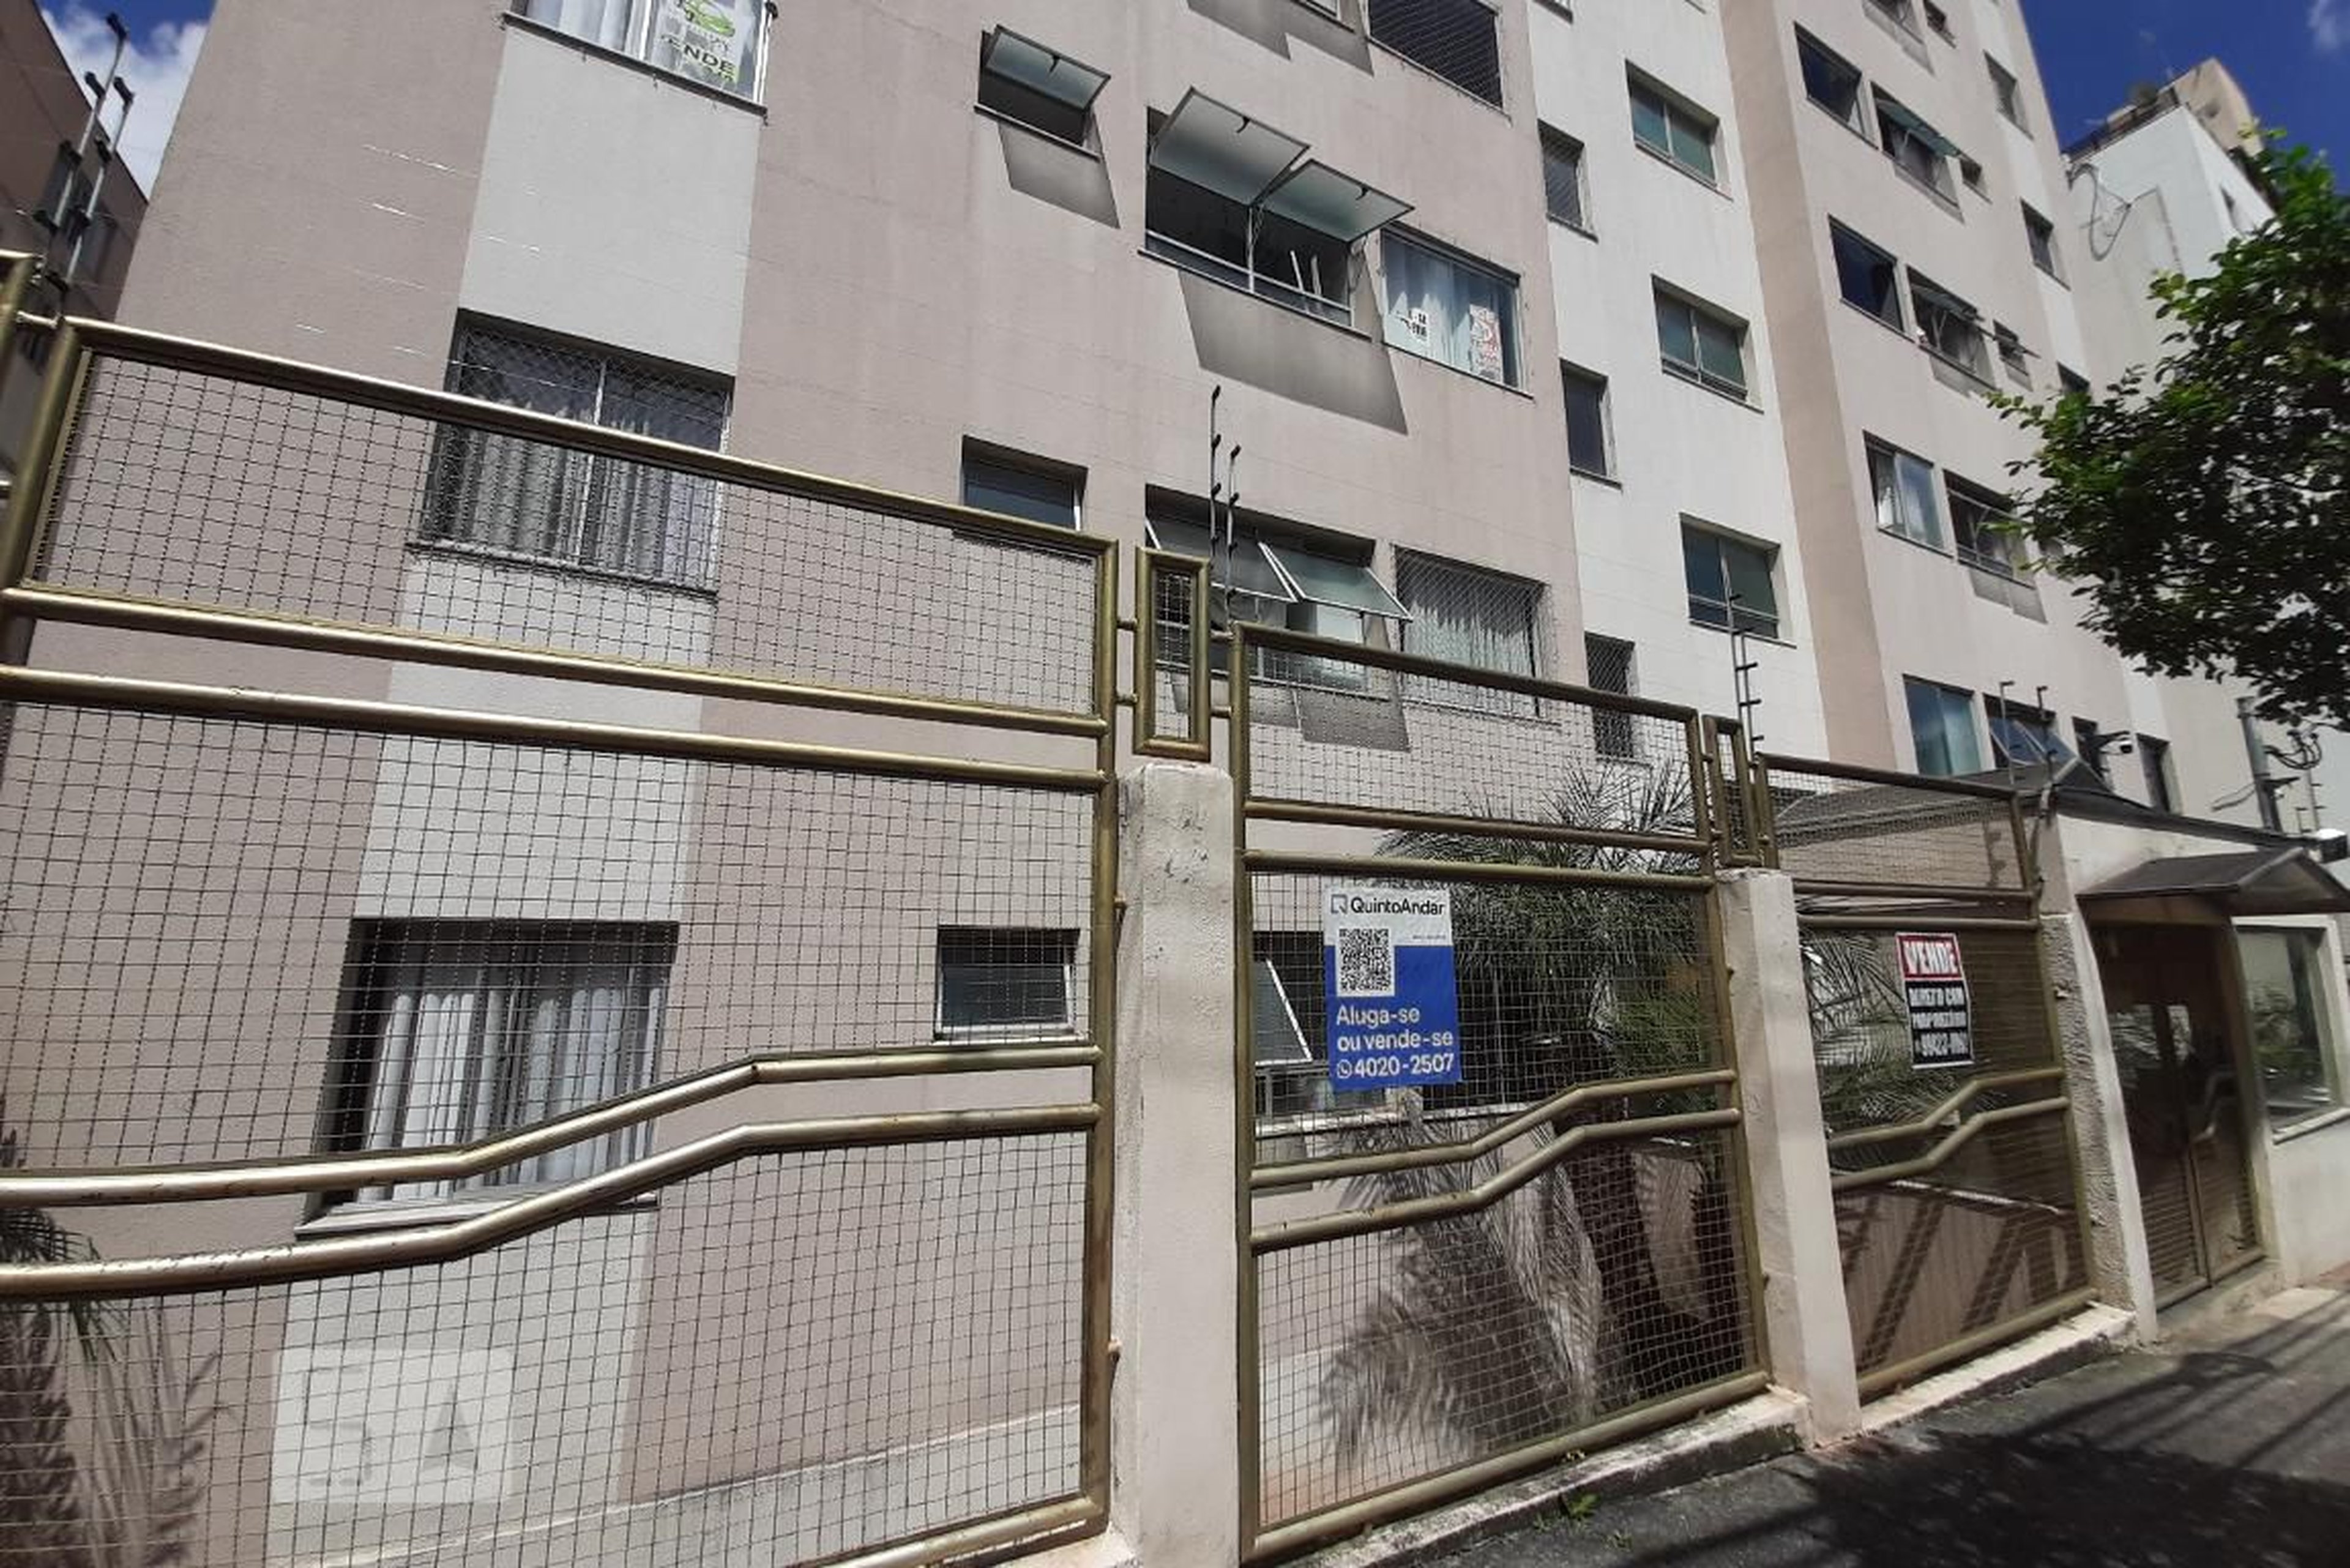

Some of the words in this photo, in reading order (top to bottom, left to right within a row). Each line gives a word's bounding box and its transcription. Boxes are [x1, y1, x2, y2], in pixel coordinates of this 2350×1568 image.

[1351, 895, 1445, 916] QuintoAndar
[1903, 940, 1959, 974] VENDE
[1336, 1004, 1420, 1029] Aluga-se
[1337, 1036, 1361, 1052] ou
[1364, 1029, 1453, 1048] vende-se
[1354, 1053, 1455, 1078] 4020-2507
